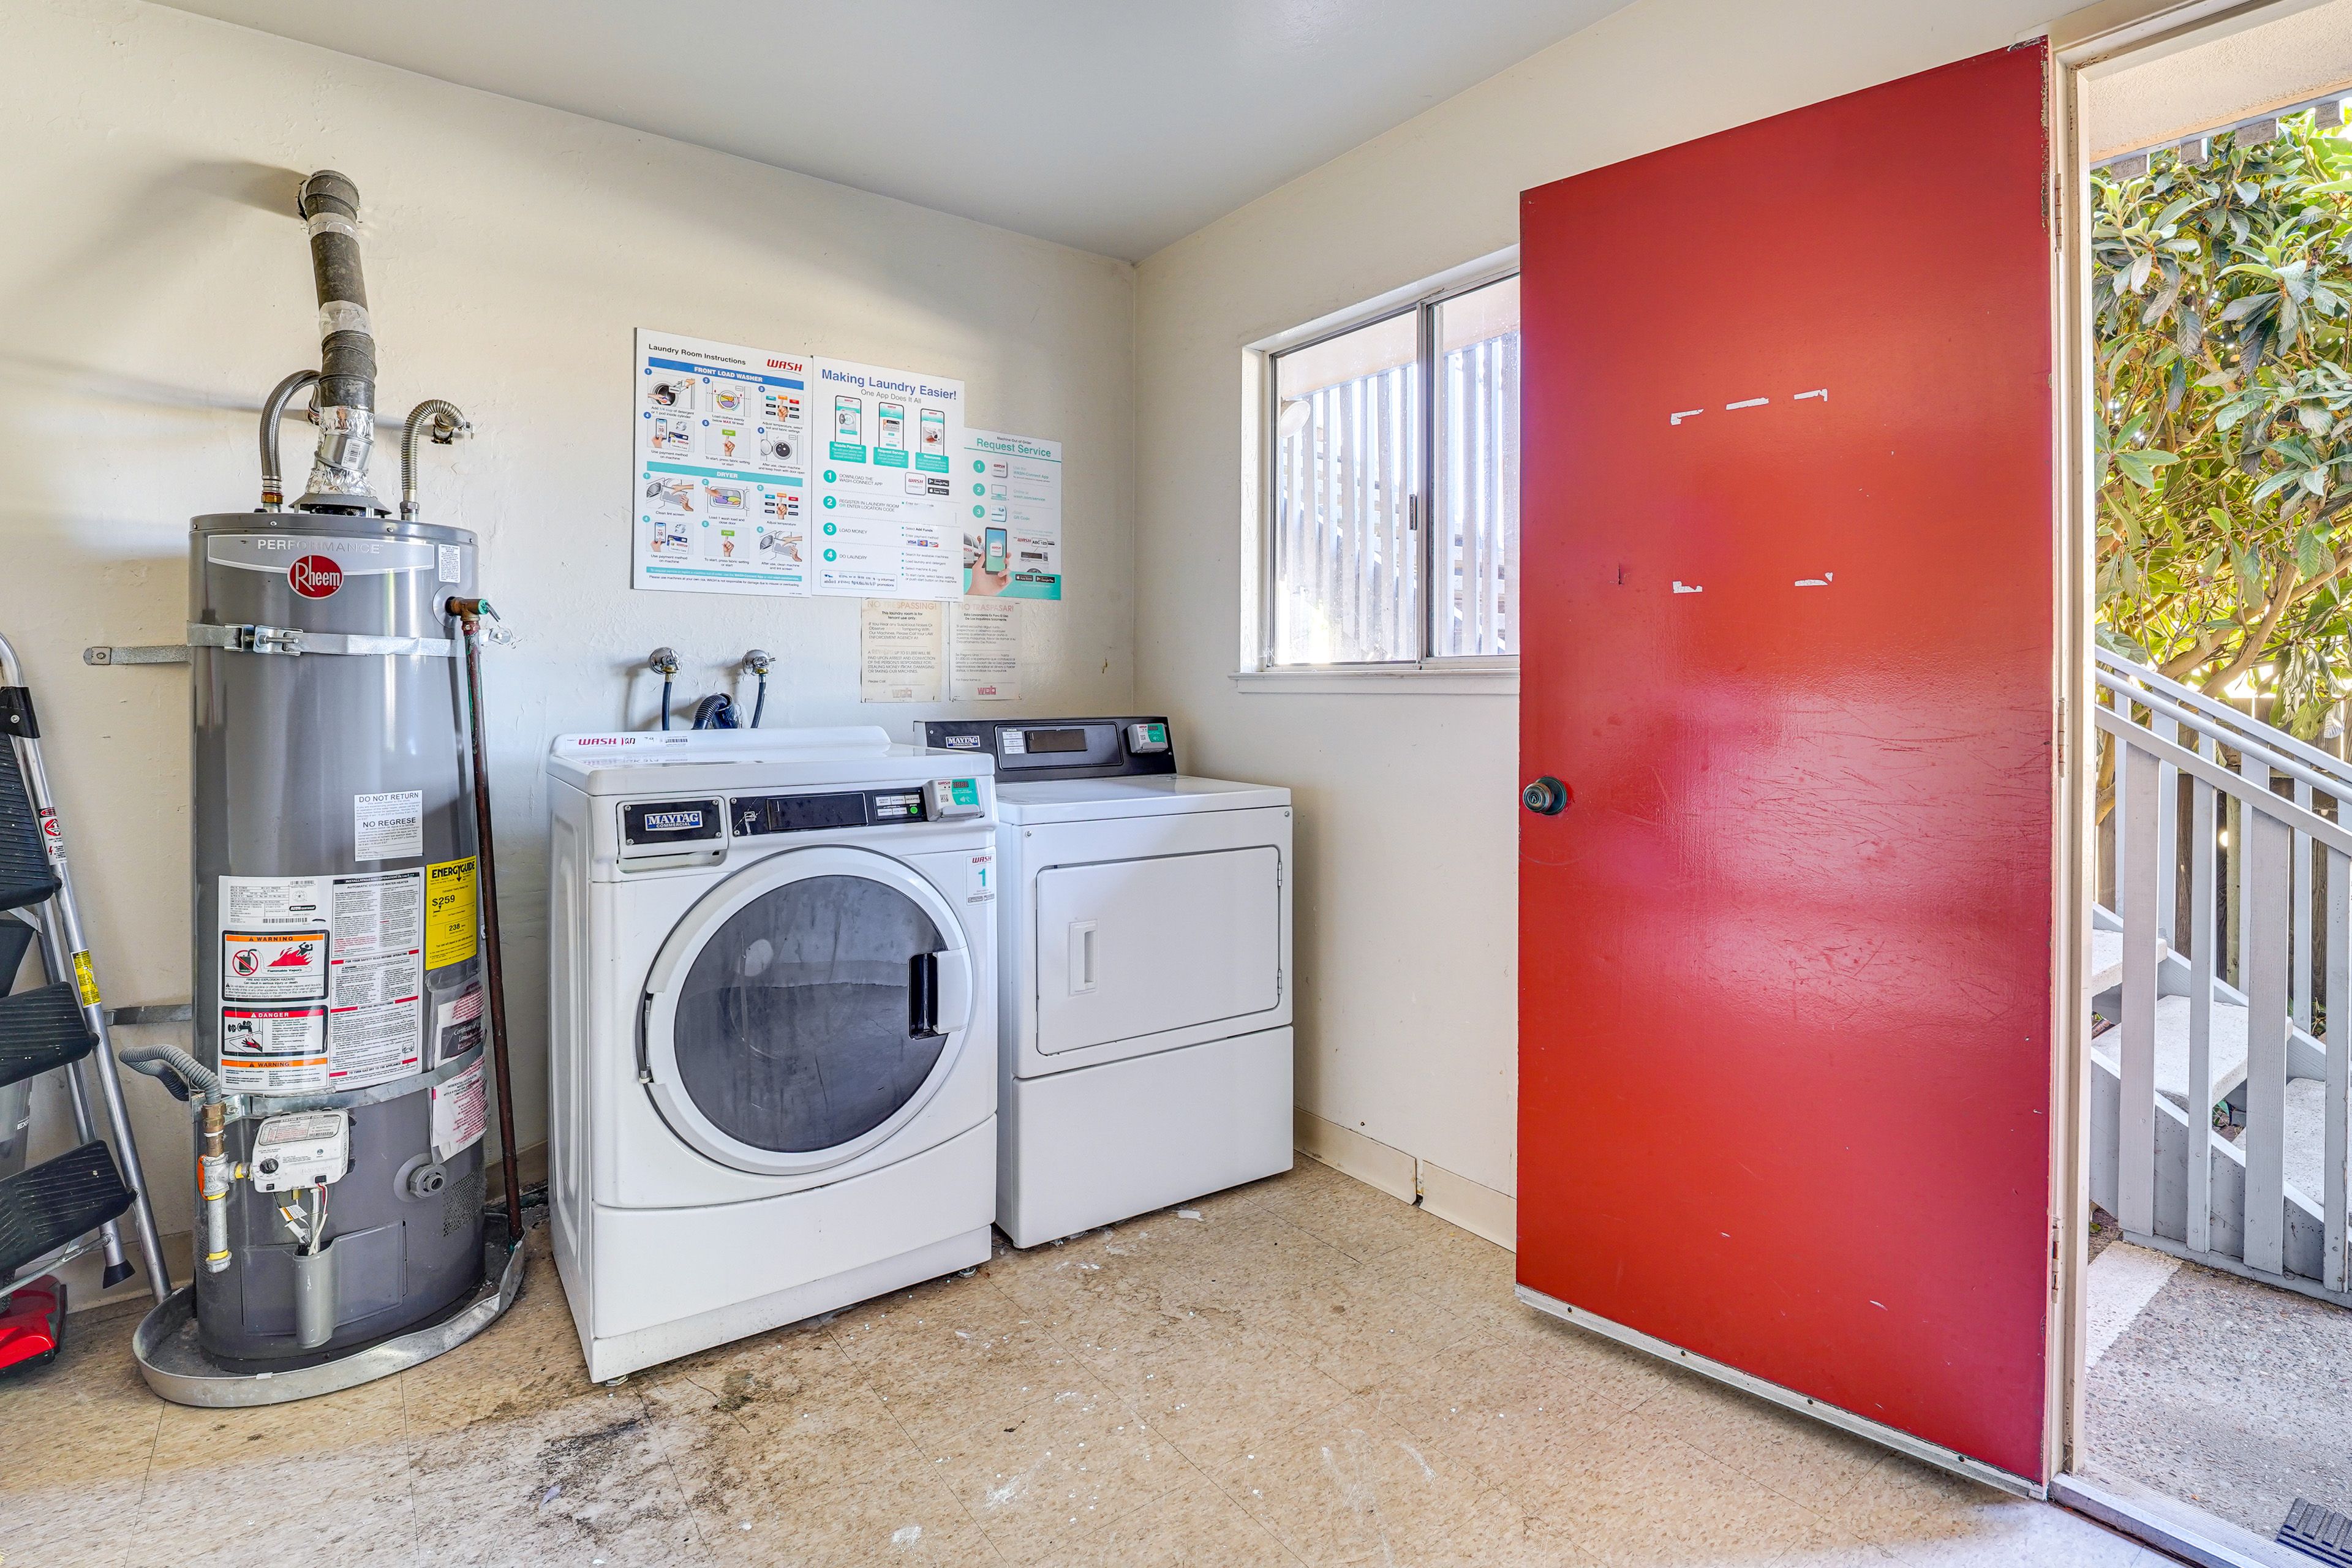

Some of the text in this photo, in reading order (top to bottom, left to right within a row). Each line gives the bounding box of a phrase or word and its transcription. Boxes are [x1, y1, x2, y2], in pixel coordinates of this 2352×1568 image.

[649, 344, 746, 365] Laundry Room Instructions
[767, 359, 802, 372] WASH
[695, 366, 716, 375] FRONT
[736, 373, 763, 382] WASHER
[821, 369, 957, 400] Making Laundry Easier!
[976, 438, 1051, 457] Request Service
[257, 540, 380, 554] PERFORMANCE
[295, 556, 341, 592] Rheem
[378, 817, 416, 826] REGRESE
[647, 812, 700, 826] MAYTAG
[432, 861, 475, 878] ENERGYGUIDE
[978, 869, 986, 887] 1
[432, 894, 455, 907] $259
